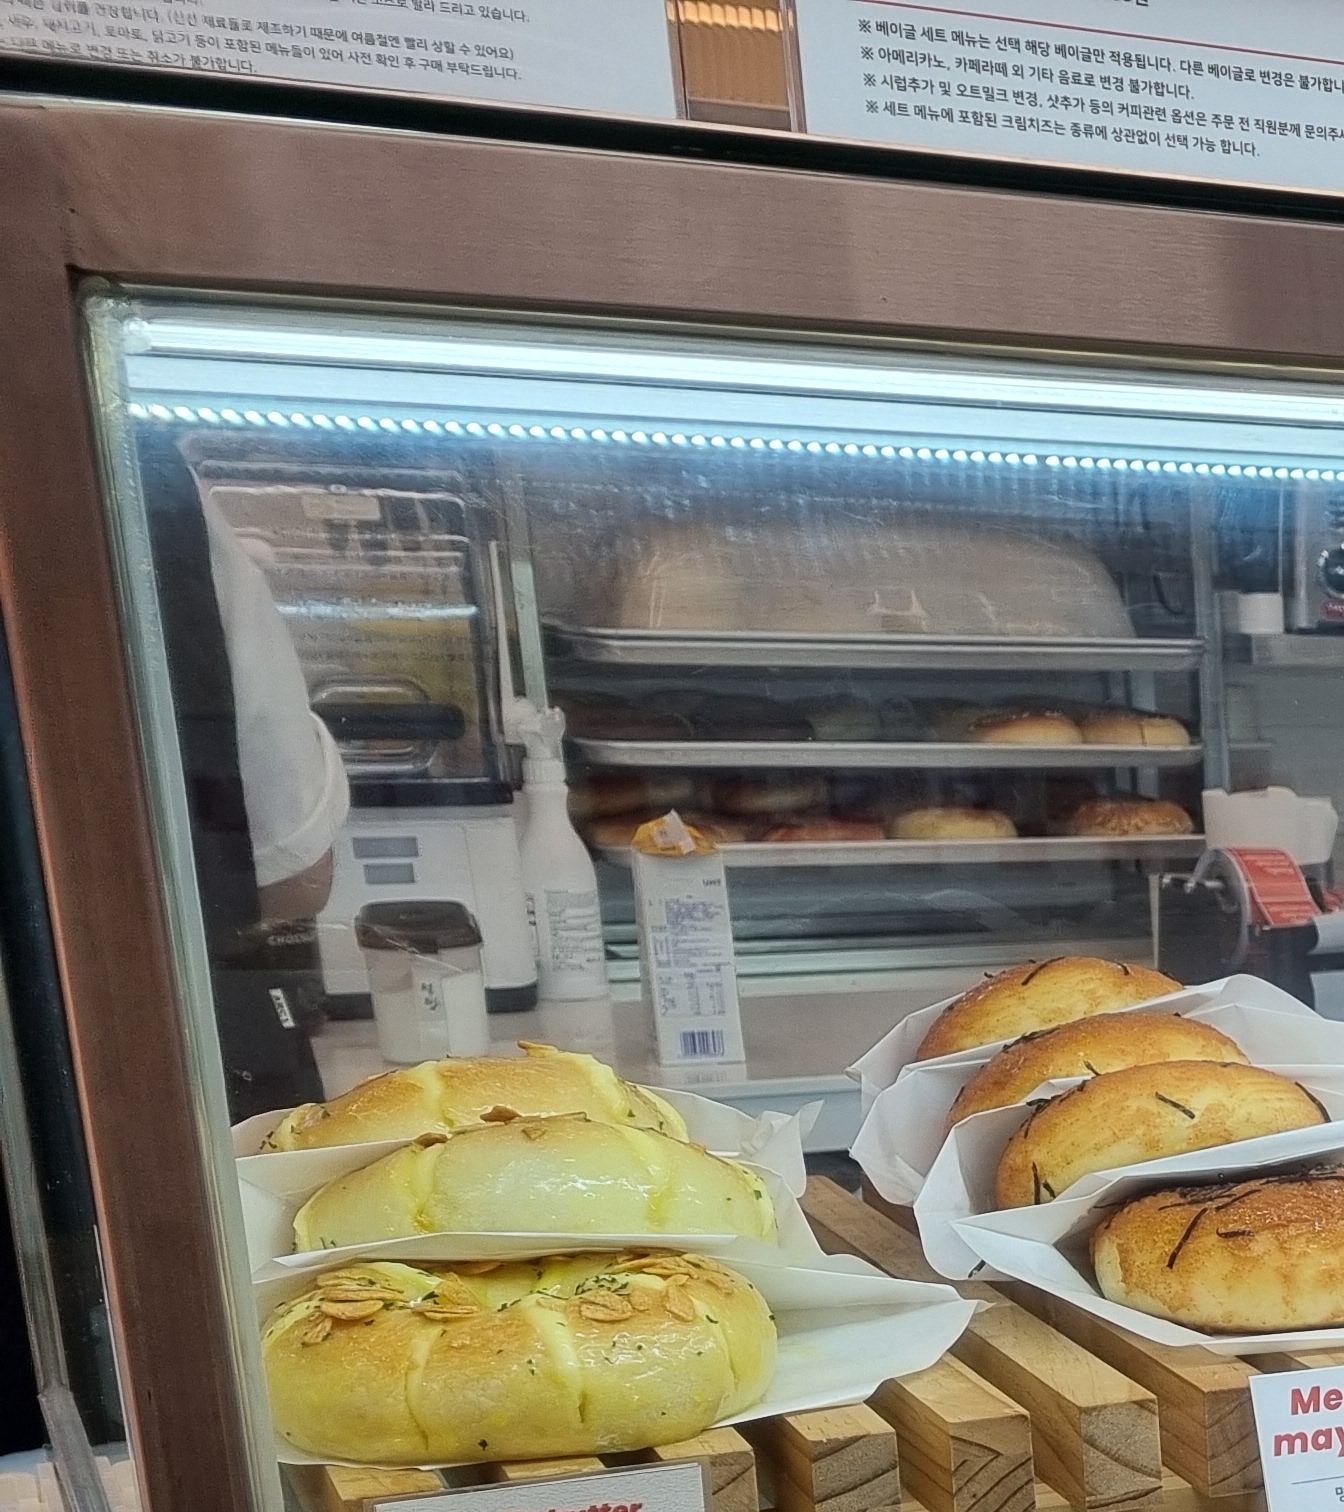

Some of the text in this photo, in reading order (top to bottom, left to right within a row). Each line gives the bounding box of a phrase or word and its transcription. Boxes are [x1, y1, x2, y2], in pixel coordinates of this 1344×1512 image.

[440, 3, 529, 23] 드리고 있습니다.
[348, 51, 522, 80] 사전 확인 후 구매 부탁드립니다.
[875, 20, 916, 40] 베이글
[921, 28, 947, 43] 세트
[951, 30, 990, 50] 메뉴는
[995, 36, 1021, 53] 선택
[1025, 39, 1050, 57] 해당
[1054, 44, 1105, 64] 베이글만
[1109, 51, 1176, 72] 적용됩니다.
[1180, 59, 1203, 75] 다른
[1208, 65, 1256, 81] 베이글로
[1260, 70, 1294, 88] 변경은
[883, 100, 1260, 156] 세트 메뉴에 포함된 크림치즈는 종류에 상관없이 선택 가능 합니다.
